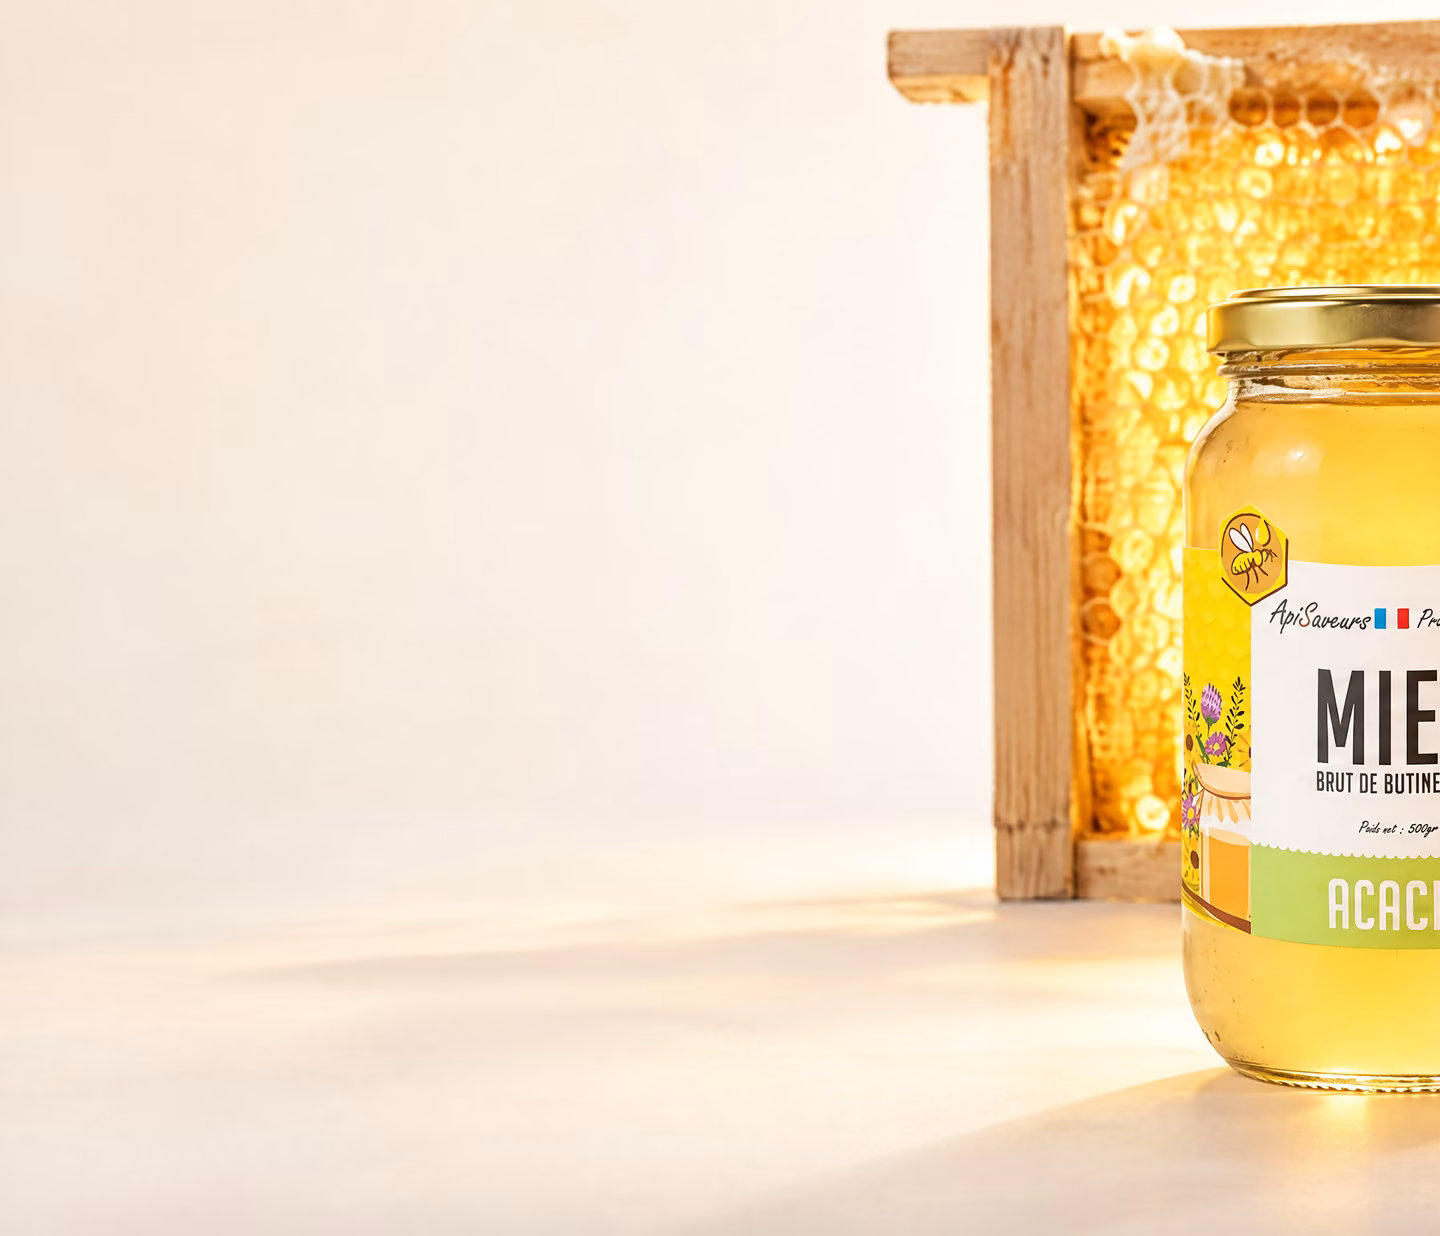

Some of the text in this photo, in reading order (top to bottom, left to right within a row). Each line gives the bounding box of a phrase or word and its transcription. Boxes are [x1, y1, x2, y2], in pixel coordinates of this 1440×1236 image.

[1270, 598, 1371, 634] ApiSaveurs
[1317, 771, 1353, 793] BRUT
[1360, 773, 1377, 793] DE
[1359, 821, 1380, 833] Poids
[1383, 825, 1397, 834] net
[1408, 824, 1438, 837] 500gr
